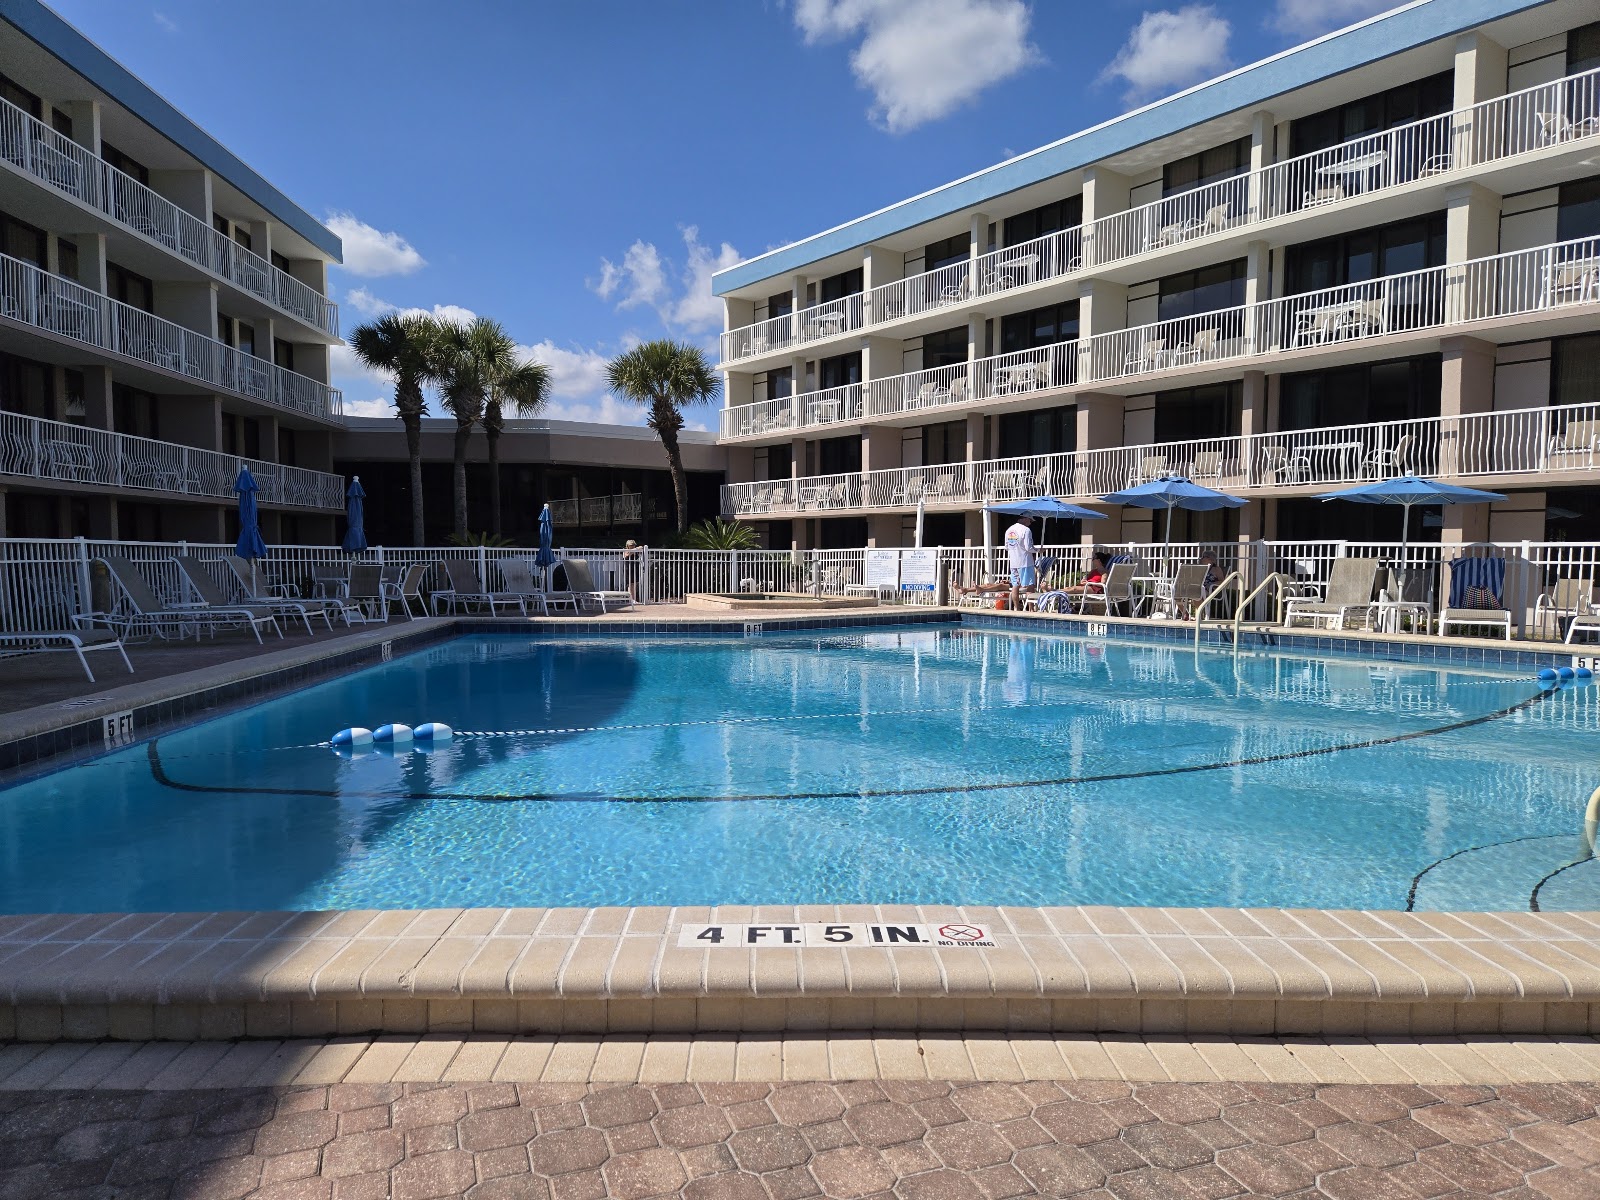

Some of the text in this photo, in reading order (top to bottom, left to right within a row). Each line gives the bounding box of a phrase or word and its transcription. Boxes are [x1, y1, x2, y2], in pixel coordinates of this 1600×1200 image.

[746, 624, 750, 632] 8
[1090, 624, 1094, 632] 8
[1578, 657, 1586, 668] 5
[108, 718, 115, 736] 5
[696, 925, 930, 944] 4 FT. 5 IN.
